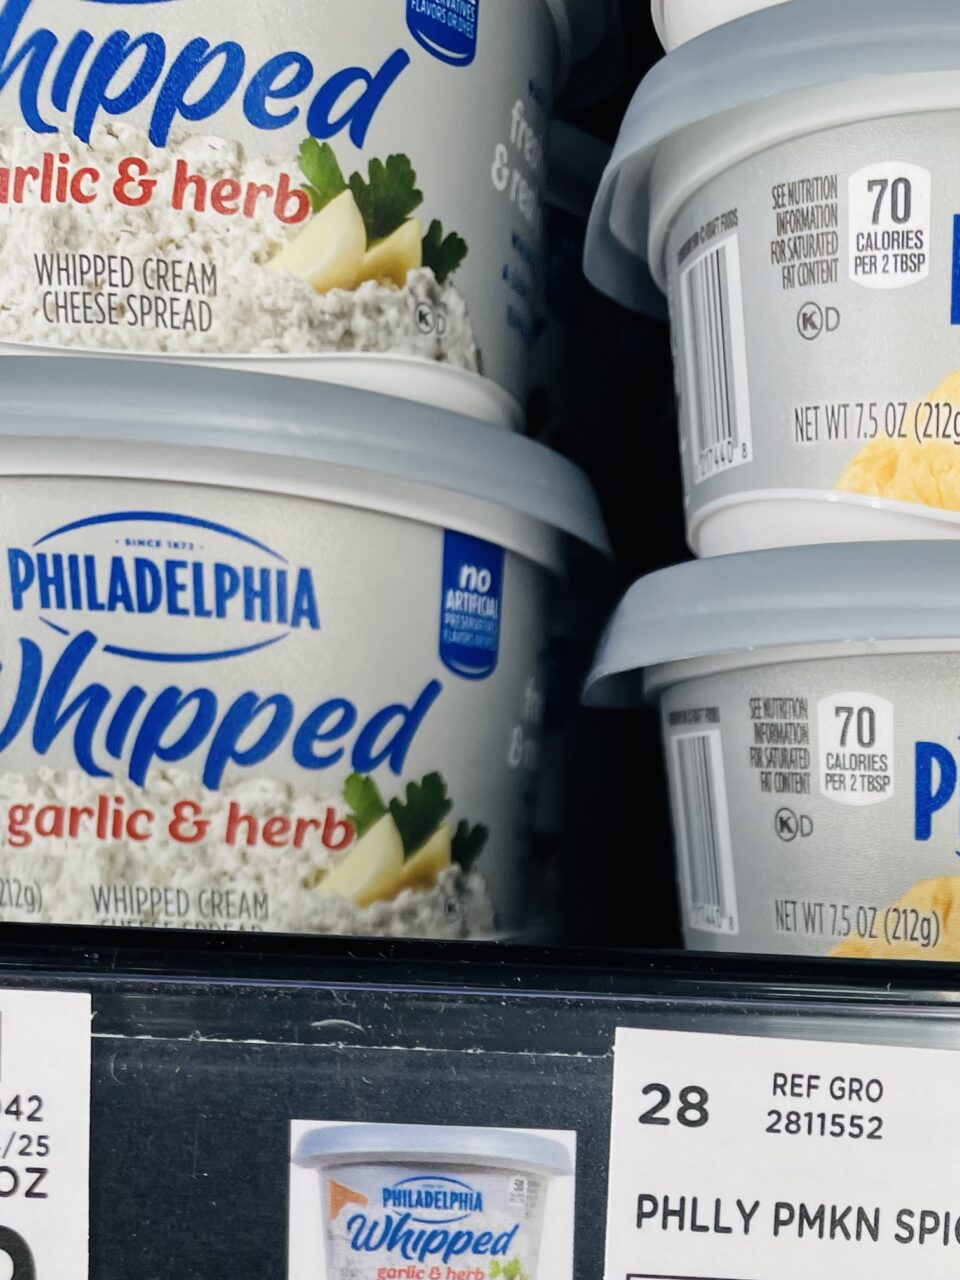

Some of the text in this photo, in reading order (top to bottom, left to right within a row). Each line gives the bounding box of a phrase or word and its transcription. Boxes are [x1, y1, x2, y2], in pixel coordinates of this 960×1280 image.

[0, 153, 310, 225] rlic & herb
[772, 174, 838, 209] SEE NUTRITION
[867, 177, 912, 225] 70
[776, 202, 838, 236] INFORMATION
[771, 230, 839, 265] FOR SATURATED
[856, 230, 924, 252] CALORIES
[34, 253, 218, 297] WHIPPED CREAM
[782, 257, 839, 289] FAT CONTENT
[855, 252, 926, 275] PER 2 TBSP
[43, 291, 212, 332] CHEESE SPREAD
[795, 405, 820, 443] NET
[826, 403, 850, 440] WT
[856, 402, 878, 439] 7.5
[885, 402, 908, 439] OZ
[125, 538, 161, 548] SINCE
[7, 548, 320, 630] PHILADELPHIA
[460, 564, 491, 593] no
[834, 706, 875, 748] 70
[826, 752, 888, 772] CALORIES
[825, 773, 890, 793] PER 2 TBSP
[7, 795, 356, 852] garlic & herb
[91, 884, 268, 920] WHIPPED CREAM
[775, 899, 797, 933] NET
[803, 901, 824, 935] WT
[830, 904, 850, 937] 7.5
[857, 906, 877, 939] OZ
[884, 907, 940, 948] (212g)
[637, 1081, 710, 1130] 28
[772, 1072, 883, 1105] REF GRO
[0, 1094, 43, 1122] 42
[765, 1109, 884, 1143] 2811552
[382, 1187, 483, 1213] PHILADELPHIA
[634, 1194, 760, 1237] PHLLY
[773, 1200, 881, 1243] PMKN
[347, 1212, 519, 1264] Whipped
[428, 1266, 442, 1280] &
